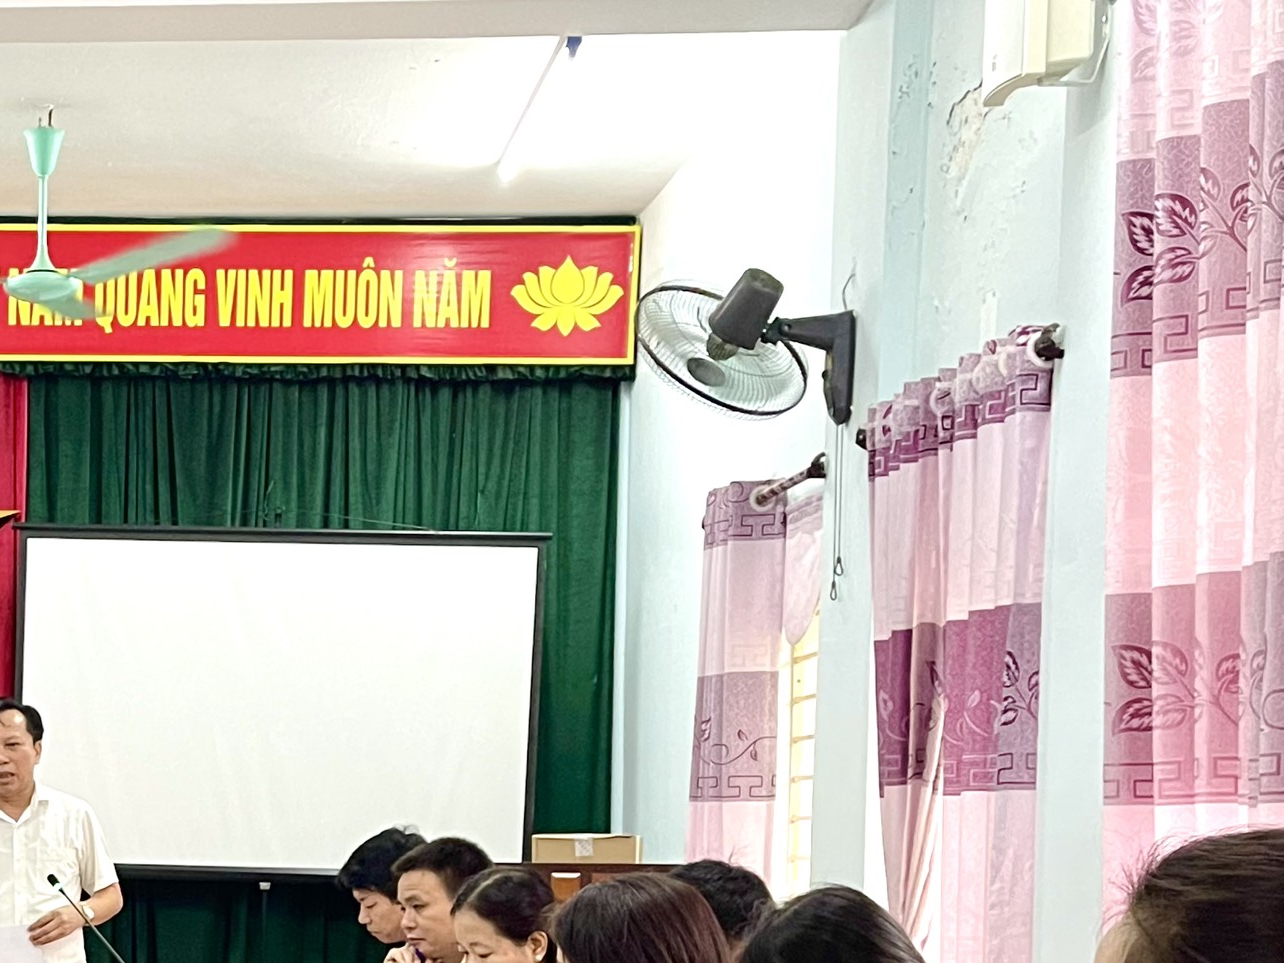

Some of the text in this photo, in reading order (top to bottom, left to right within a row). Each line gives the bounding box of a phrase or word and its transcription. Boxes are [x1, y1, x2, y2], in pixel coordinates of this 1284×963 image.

[94, 269, 206, 334] QUANG
[216, 269, 293, 328] VINH
[303, 257, 404, 328] MUÔN
[413, 256, 492, 328] NĂM
